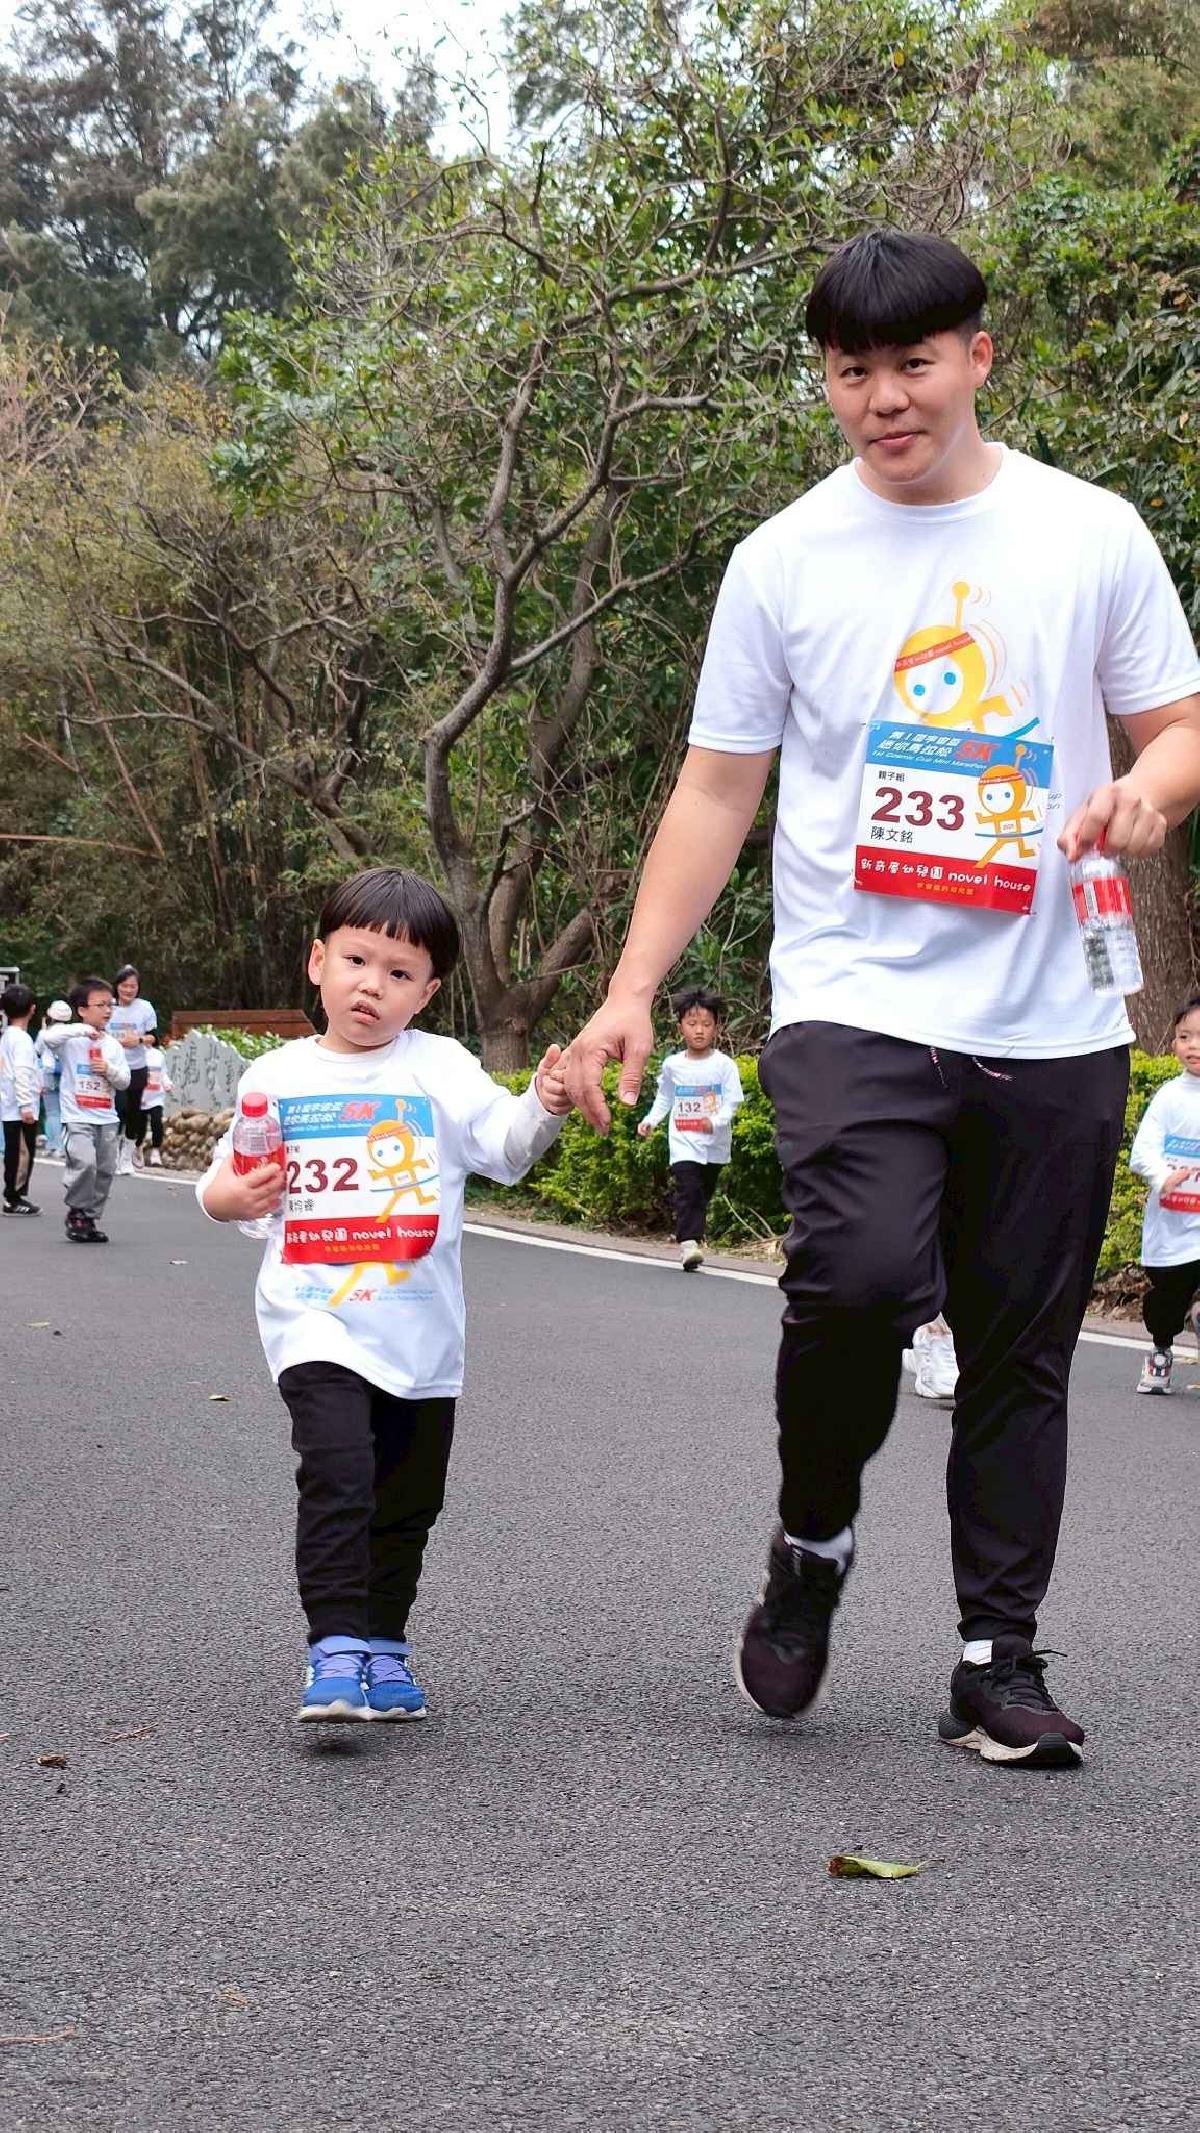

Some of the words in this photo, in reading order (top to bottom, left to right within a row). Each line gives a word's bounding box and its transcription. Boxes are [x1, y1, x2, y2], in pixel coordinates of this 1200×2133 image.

[871, 786, 965, 831] 233
[871, 825, 913, 843] 陳文銘
[947, 870, 988, 886] novel
[994, 874, 1032, 892] house
[679, 1101, 701, 1112] 132
[287, 1157, 359, 1194] 232
[352, 1227, 392, 1240] novel
